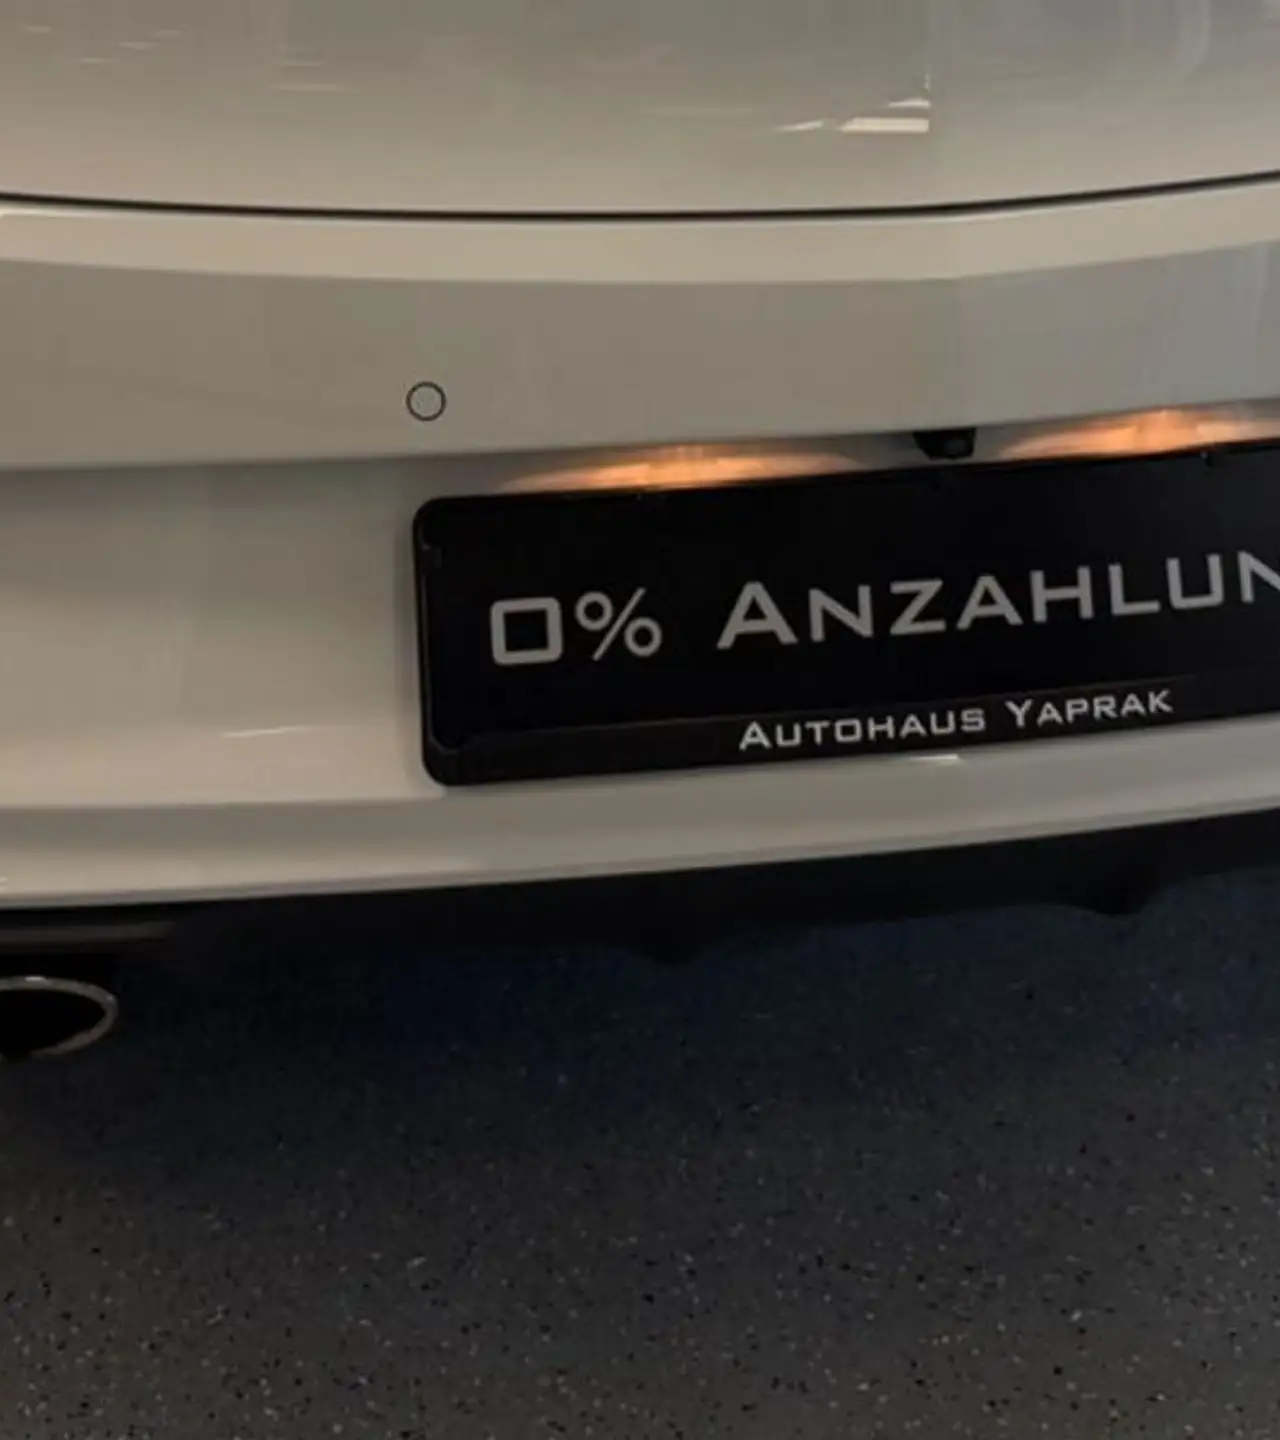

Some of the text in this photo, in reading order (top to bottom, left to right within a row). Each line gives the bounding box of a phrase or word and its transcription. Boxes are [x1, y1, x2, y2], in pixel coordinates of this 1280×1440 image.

[489, 586, 663, 663] 0%
[738, 689, 1175, 751] AUTOHAUS YAPRAK
